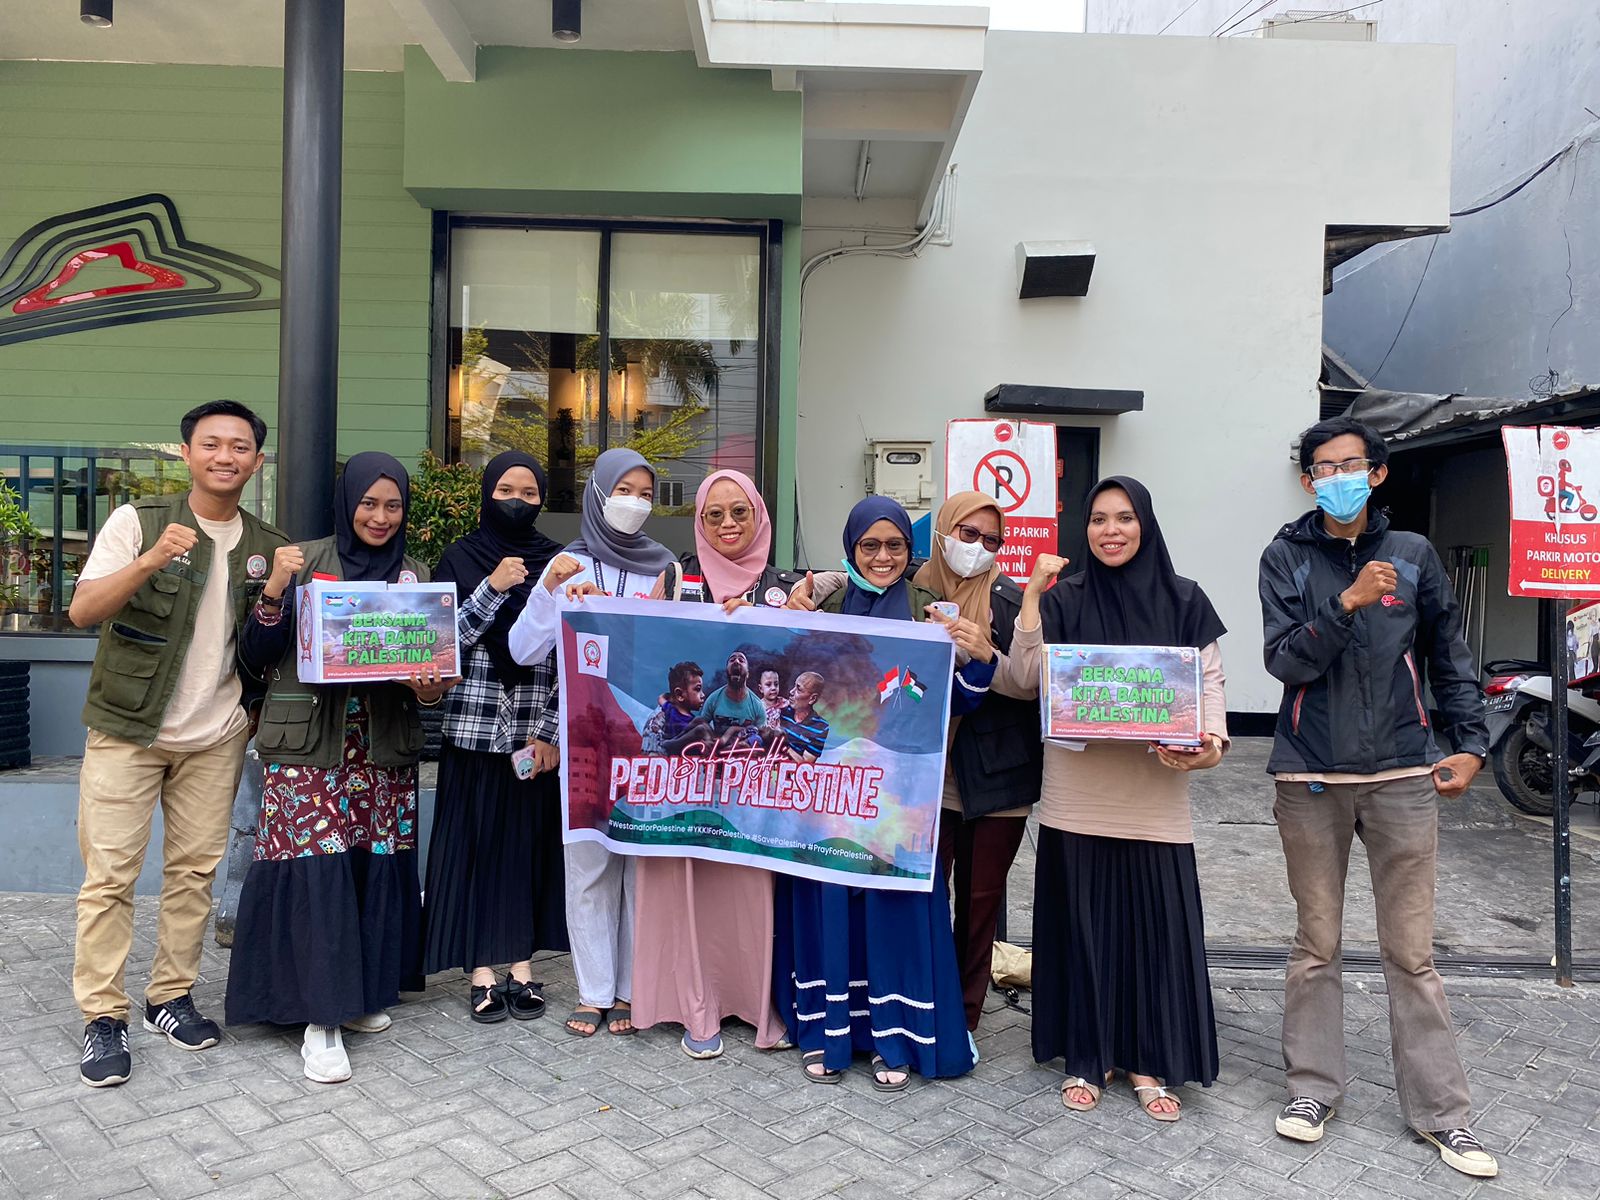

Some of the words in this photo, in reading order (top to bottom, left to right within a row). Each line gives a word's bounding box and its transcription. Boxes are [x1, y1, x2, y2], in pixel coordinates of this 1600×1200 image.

[1013, 526, 1050, 538] PARKIR
[1544, 532, 1588, 545] KHUSUS
[997, 544, 1033, 556] NJANG
[1526, 549, 1561, 562] PARKIR
[1012, 561, 1026, 573] INI
[1541, 567, 1591, 580] DELIVERY
[352, 612, 428, 628] BERSAMA
[342, 630, 381, 646] KITA
[384, 629, 437, 646] BANTU
[347, 648, 433, 665] PALESTINA
[1081, 666, 1165, 684] BERSAMA
[1071, 685, 1112, 702] KITA
[1117, 686, 1176, 705] BANTU
[1076, 706, 1171, 723] PALESTINA
[608, 756, 717, 804] PEDULI
[719, 759, 883, 818] PALESTINE
[751, 834, 806, 850] #SavePalestine
[807, 842, 874, 861] #PrayForPalestine
